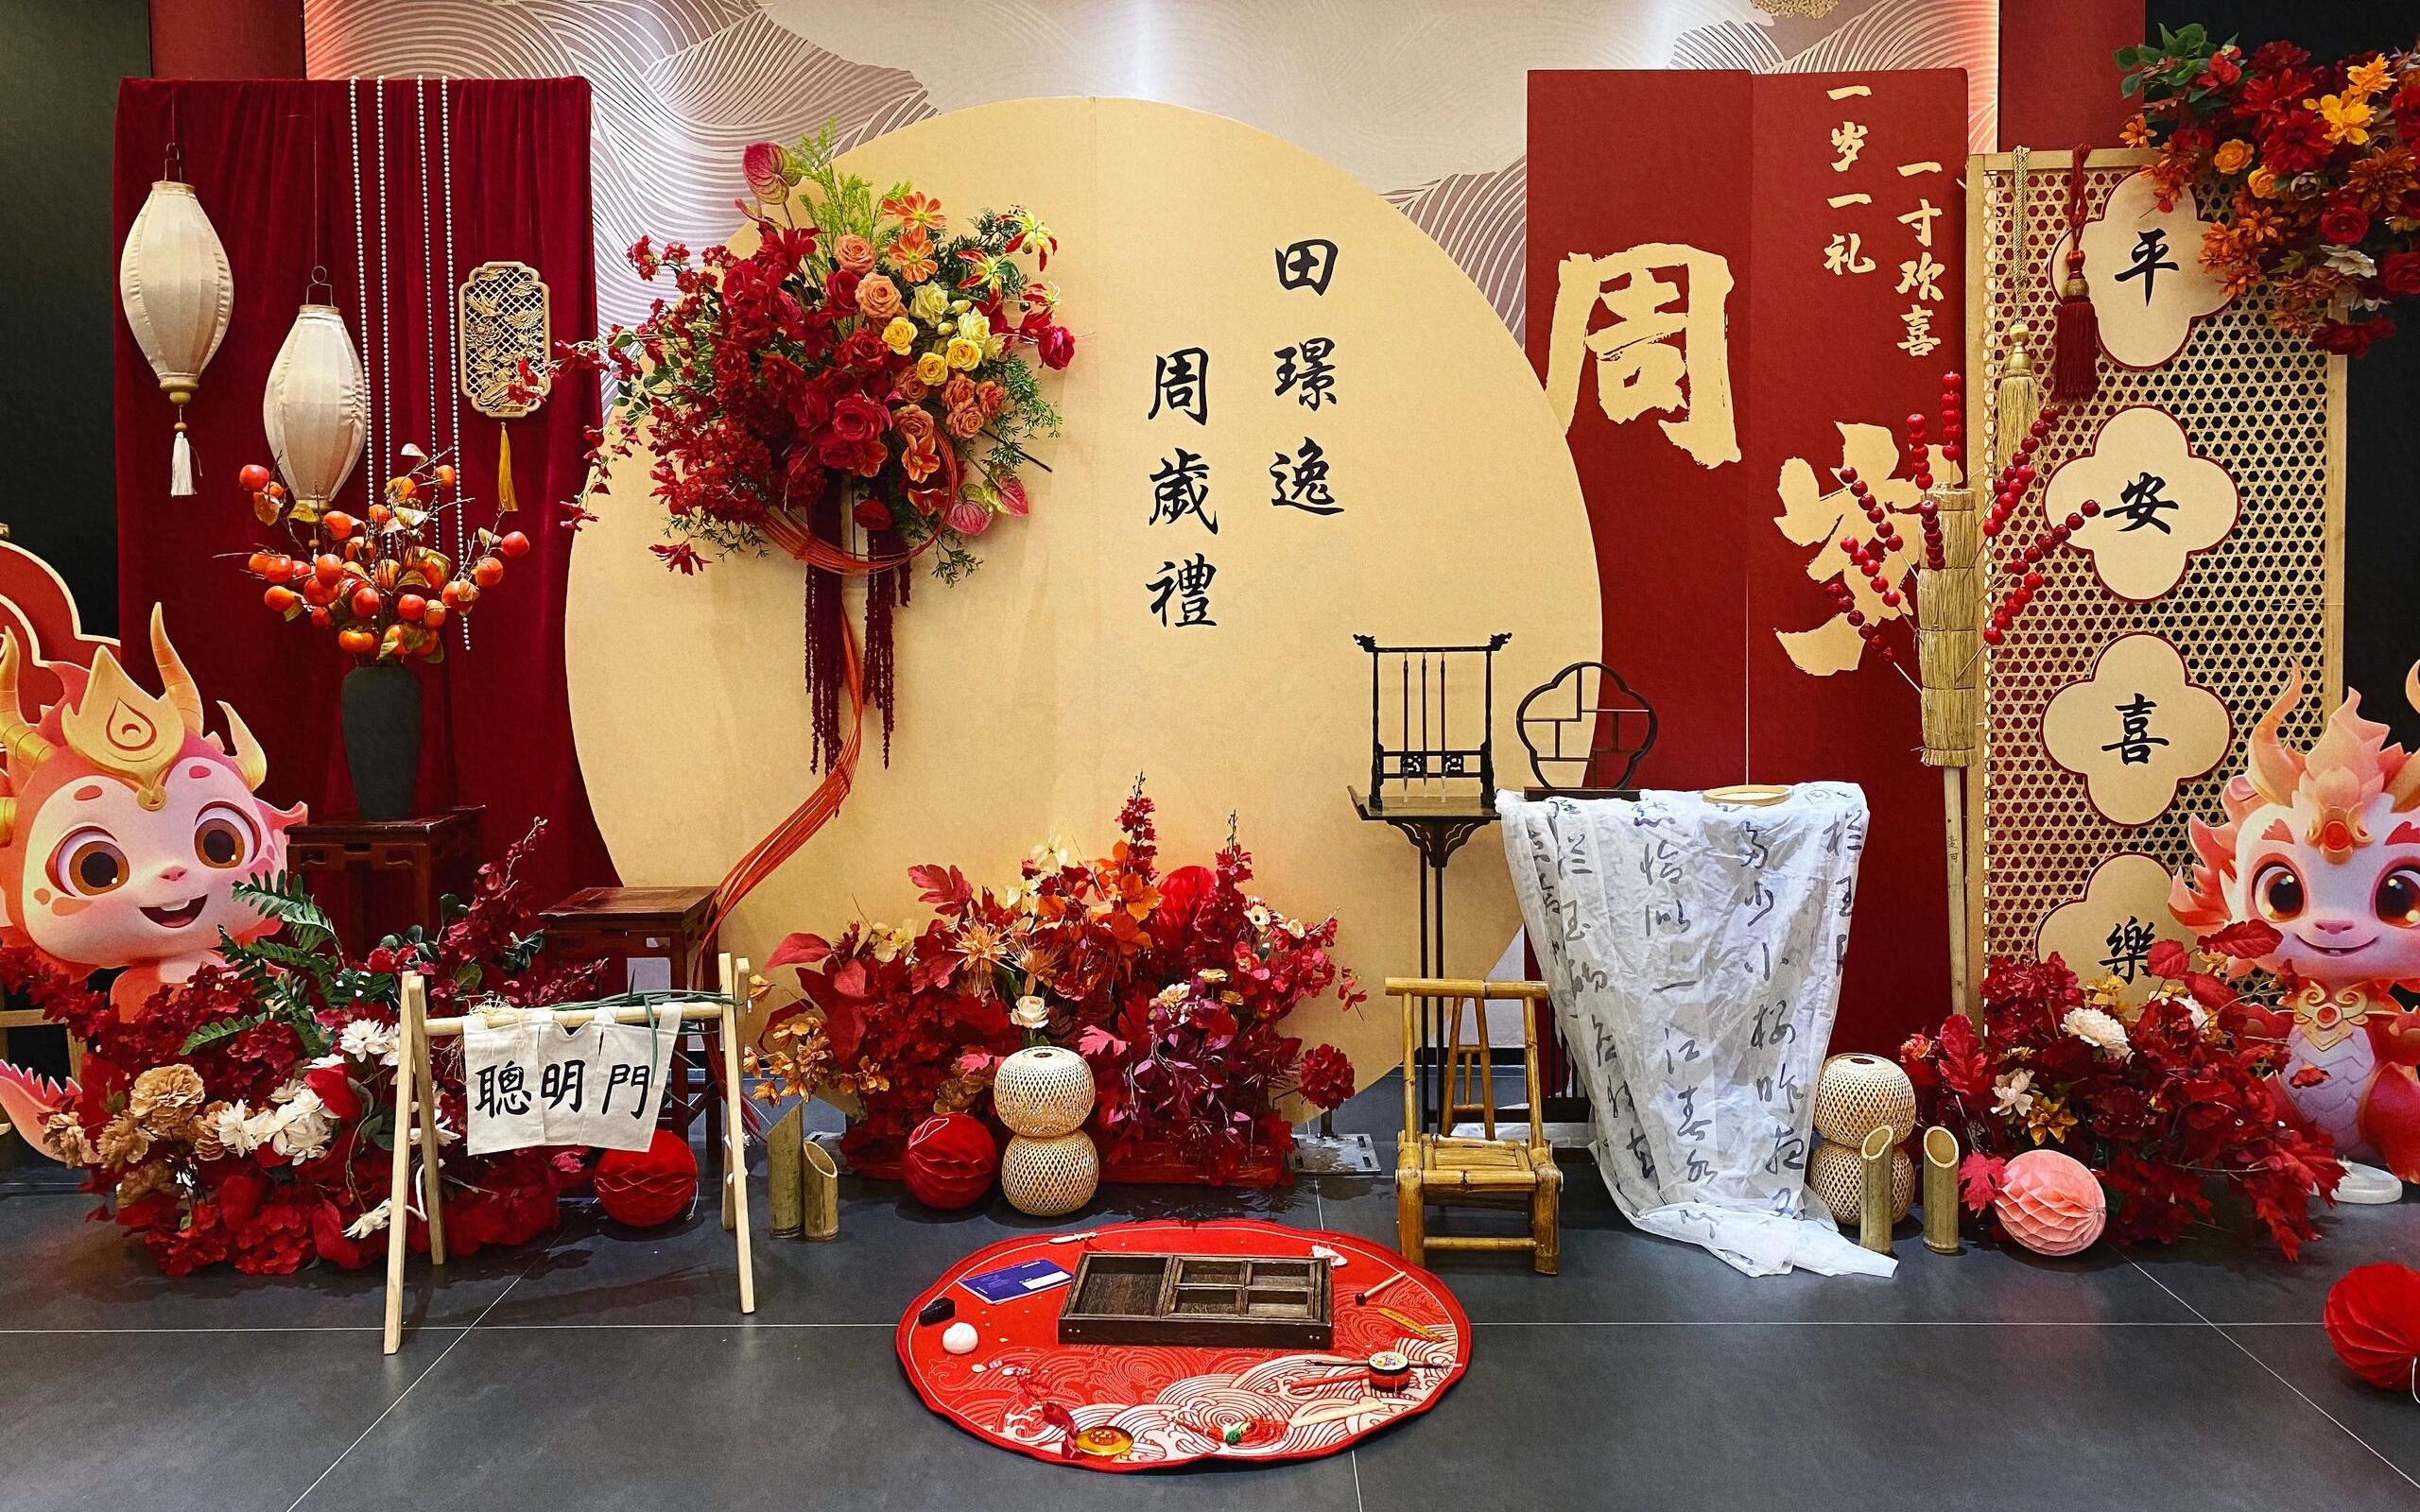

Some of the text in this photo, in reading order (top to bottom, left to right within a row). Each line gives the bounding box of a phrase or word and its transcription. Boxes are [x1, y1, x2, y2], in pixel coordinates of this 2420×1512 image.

[1824, 83, 1877, 277] 一岁一礼
[1894, 160, 1947, 358] 一寸欢喜
[1270, 238, 1346, 517] 田璟逸
[1145, 347, 1219, 628] 周歲禮
[475, 1059, 651, 1122] 聰明門
